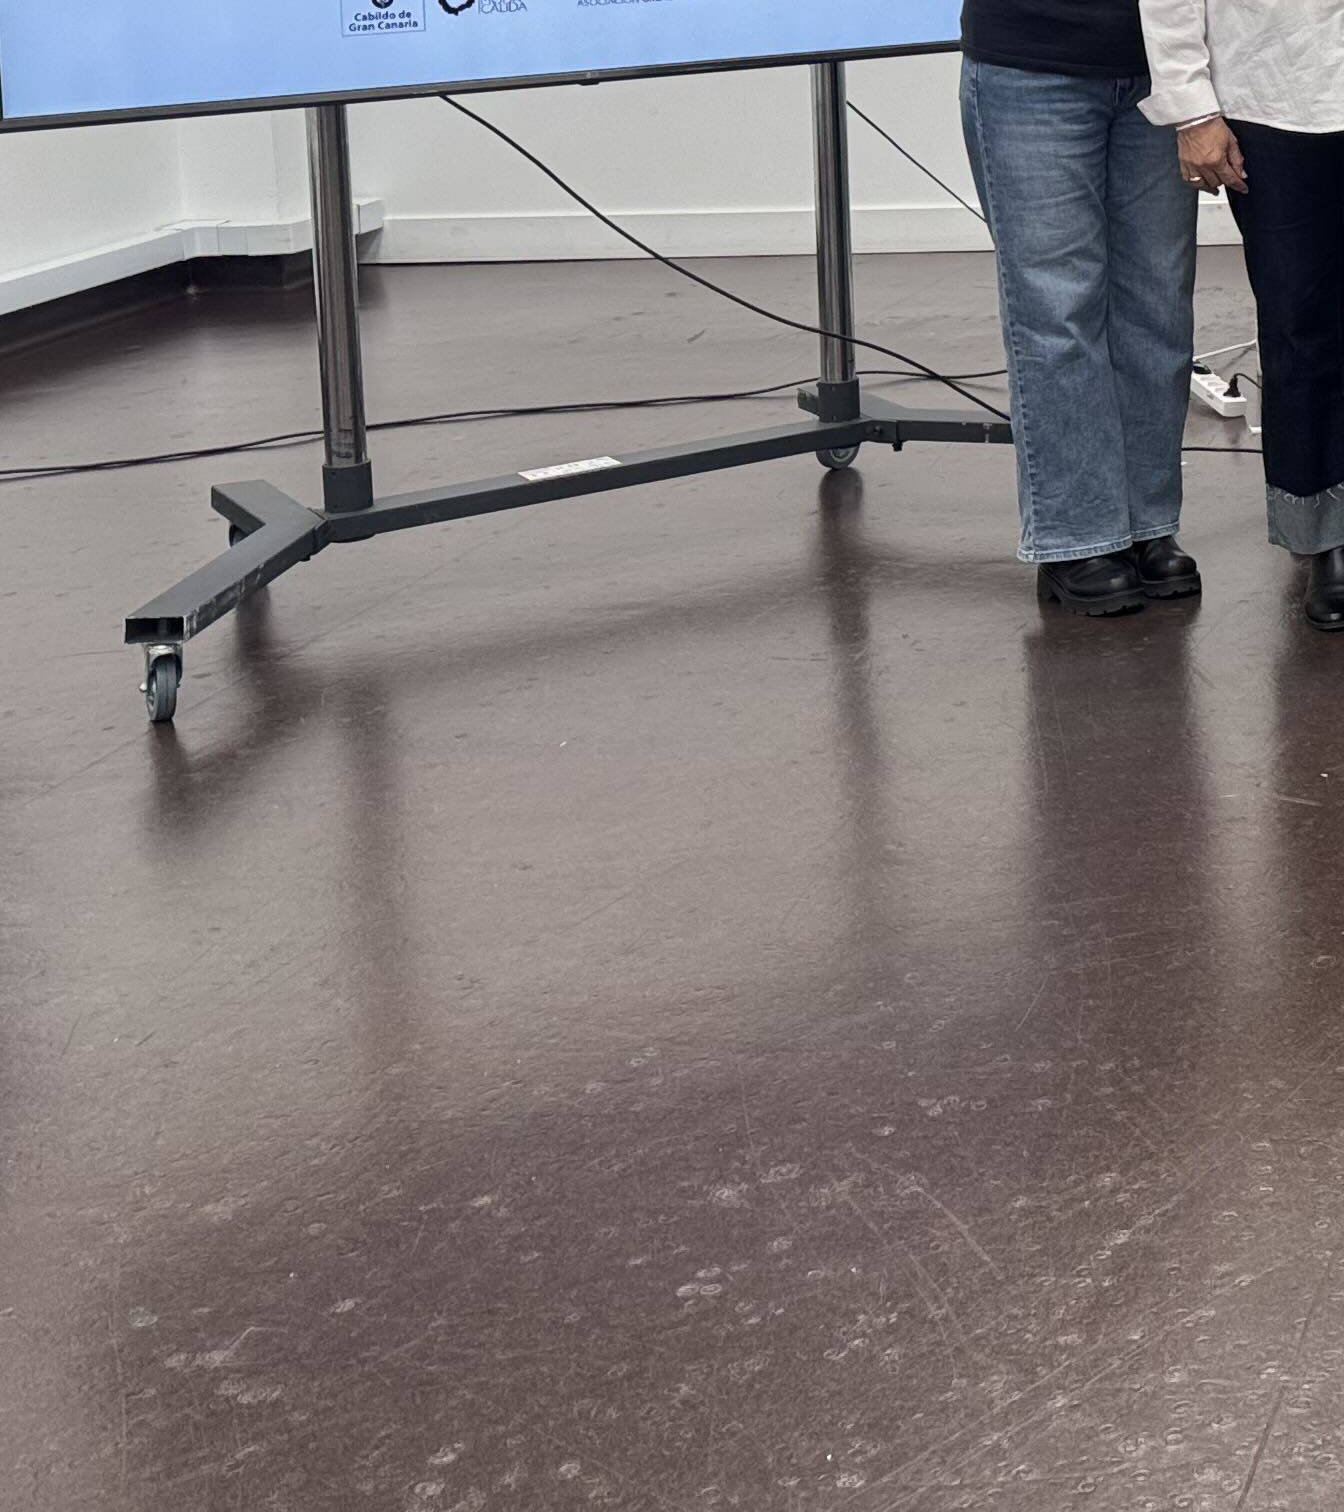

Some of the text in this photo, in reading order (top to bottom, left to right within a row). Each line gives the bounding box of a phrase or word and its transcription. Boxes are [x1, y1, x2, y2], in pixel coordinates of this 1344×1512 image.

[353, 9, 412, 22] Cabildo de
[348, 19, 418, 32] Gran Canaria
